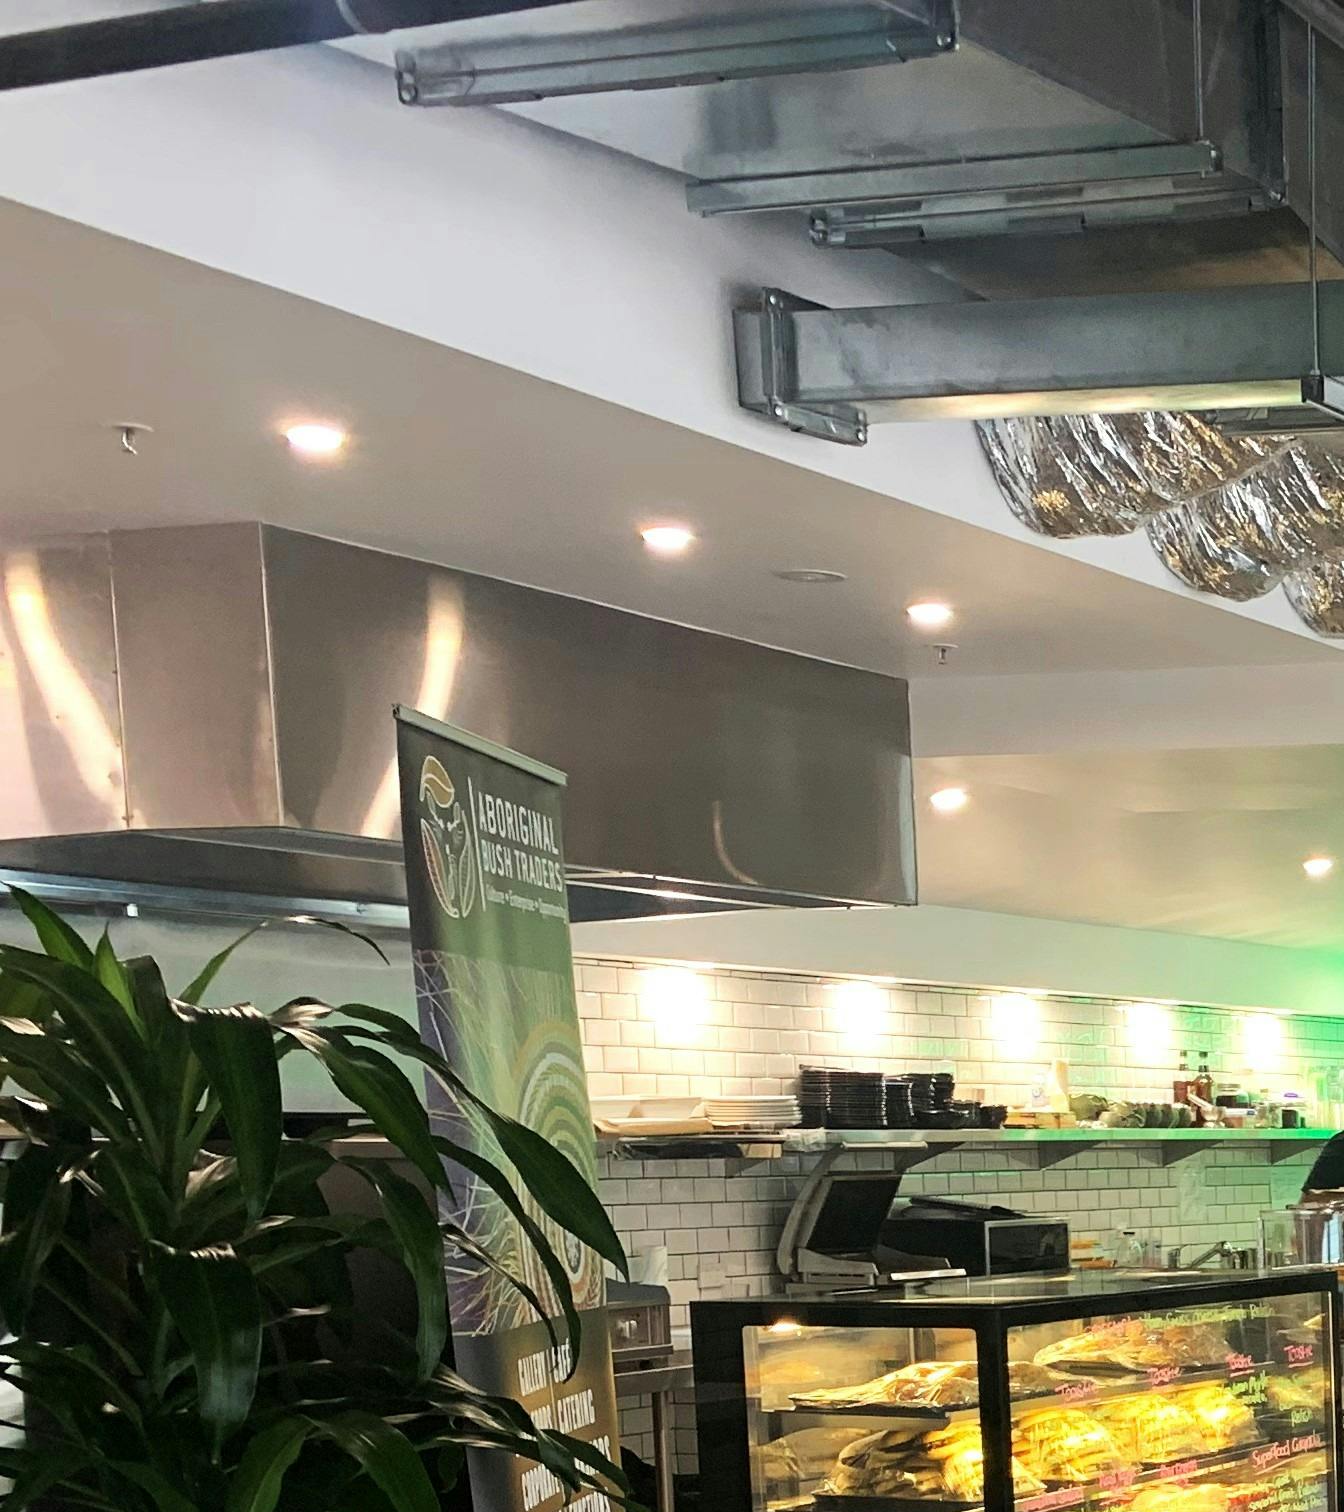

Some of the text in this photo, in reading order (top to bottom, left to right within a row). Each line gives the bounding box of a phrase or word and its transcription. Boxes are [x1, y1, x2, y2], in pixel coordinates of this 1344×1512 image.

[478, 791, 560, 856] ABORIGINAL
[481, 839, 564, 893] BUSH TRADERS
[517, 1350, 548, 1397] GALLERY
[557, 1388, 596, 1435] CATERING
